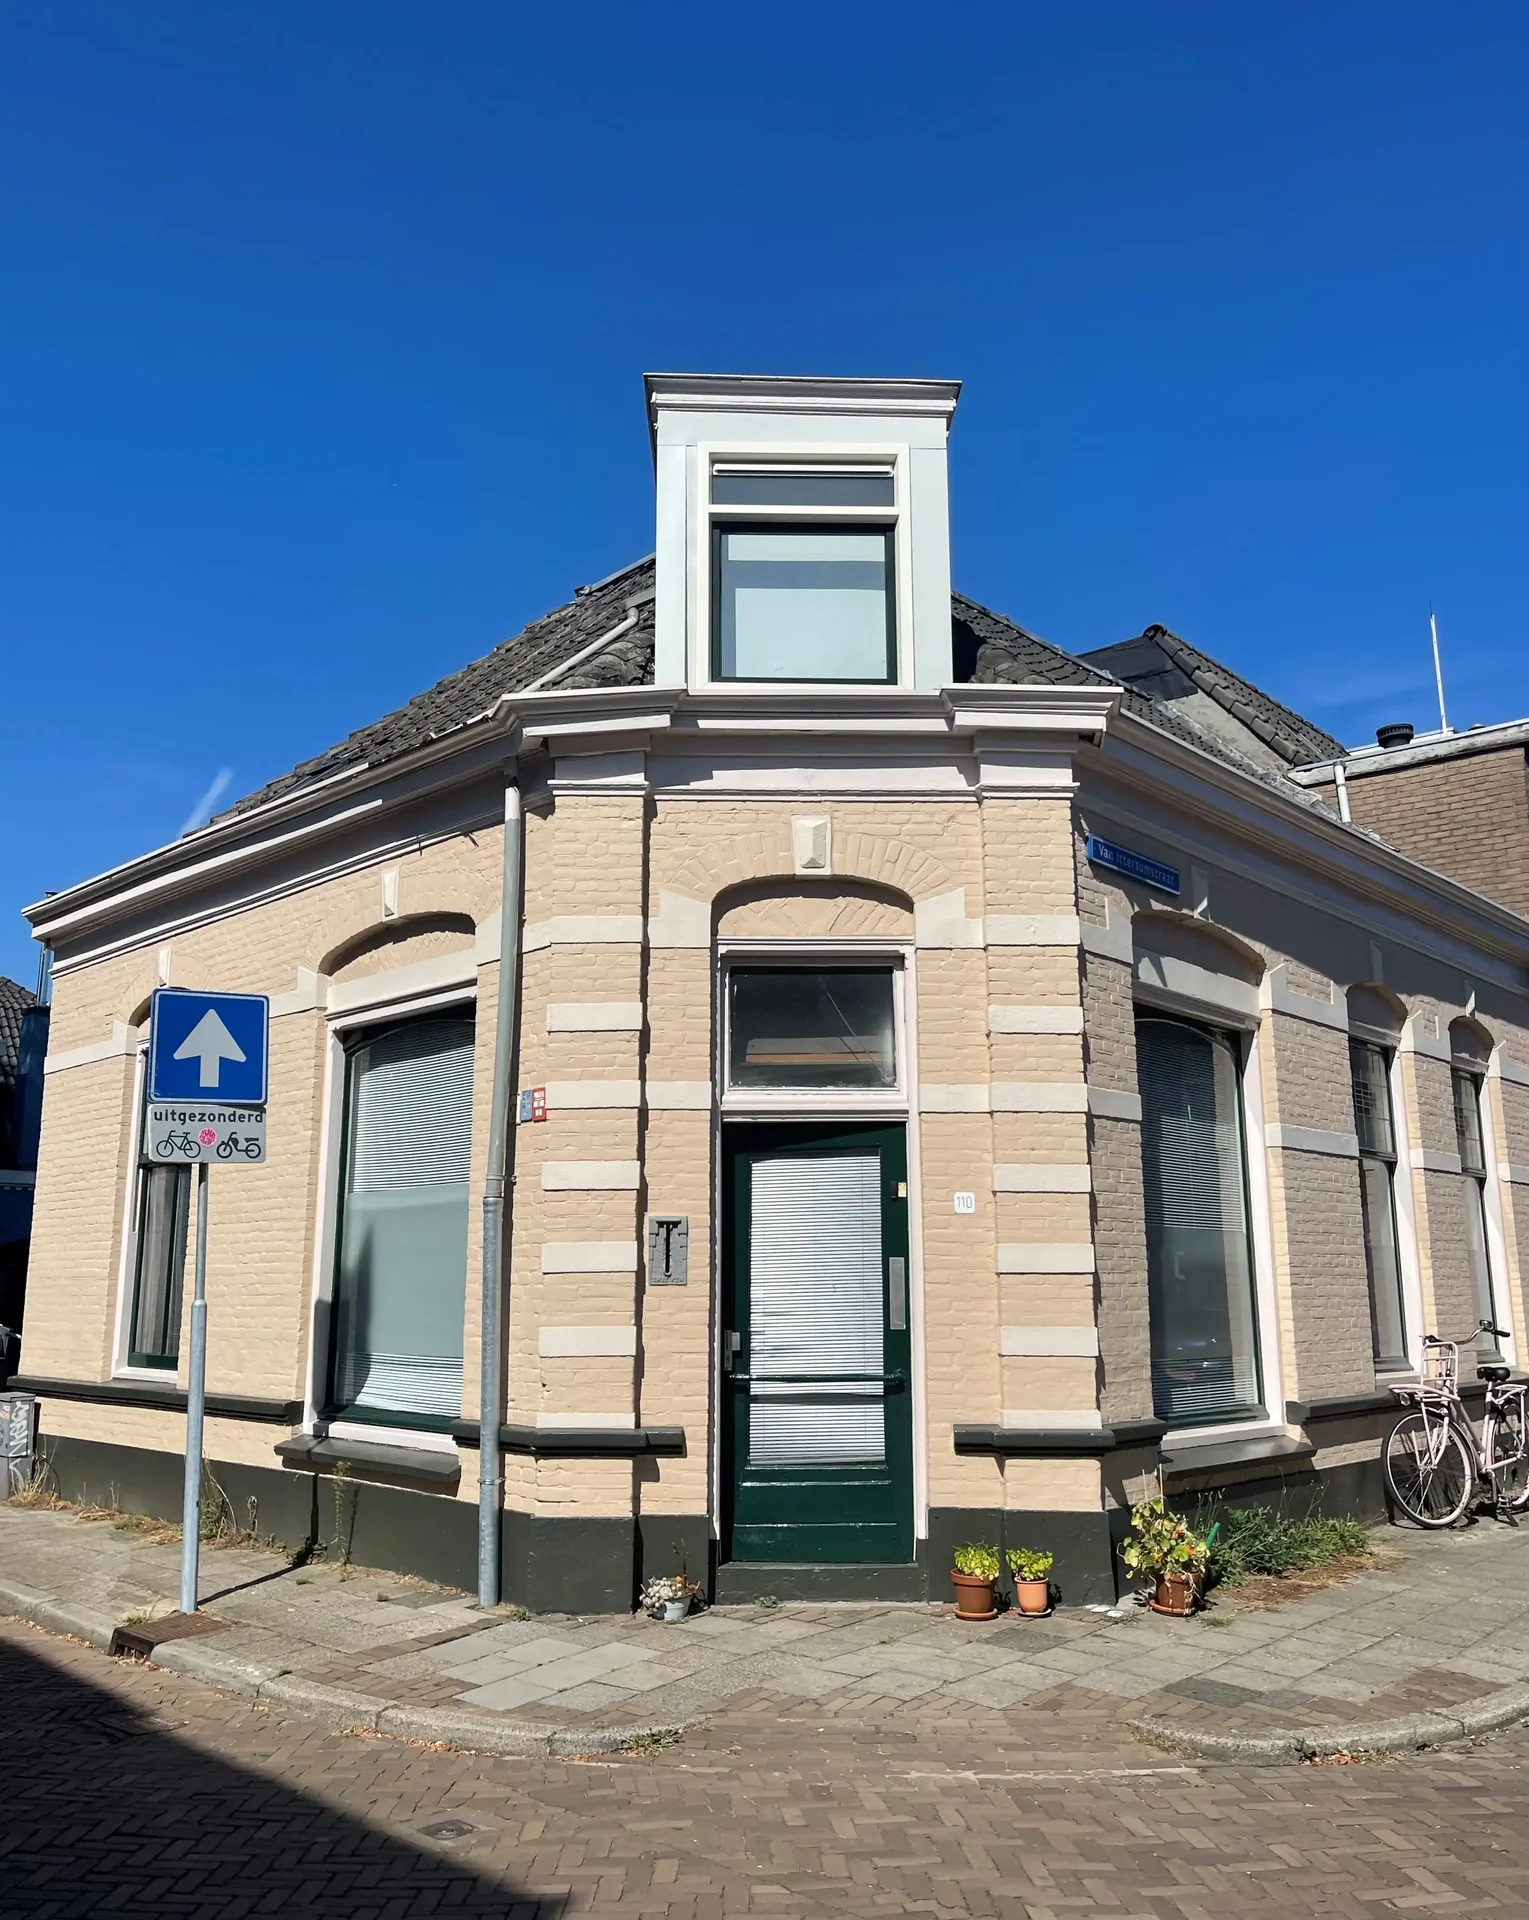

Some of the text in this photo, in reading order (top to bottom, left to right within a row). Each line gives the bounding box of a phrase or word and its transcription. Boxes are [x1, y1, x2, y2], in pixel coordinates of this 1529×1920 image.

[1098, 843, 1175, 885] Van Ittersumstraat
[154, 1109, 263, 1125] uitgezonderd
[956, 1195, 973, 1209] 110
